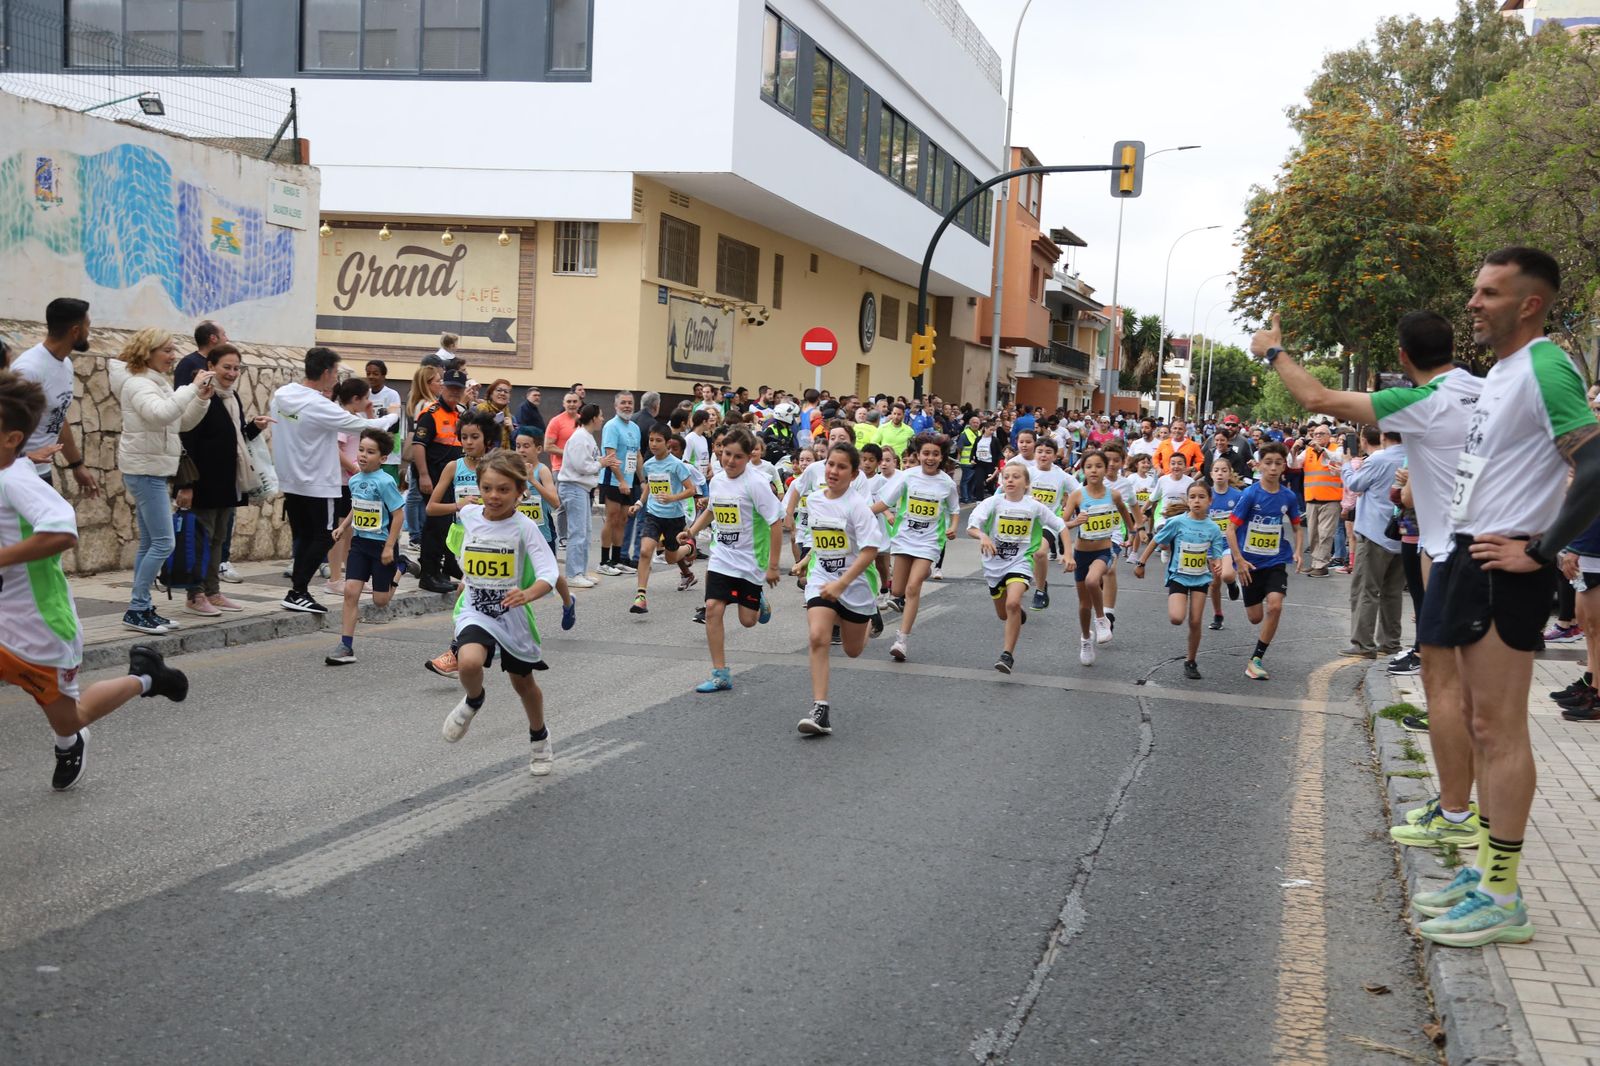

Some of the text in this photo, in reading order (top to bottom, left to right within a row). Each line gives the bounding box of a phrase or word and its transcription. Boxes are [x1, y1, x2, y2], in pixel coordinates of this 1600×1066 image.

[321, 240, 344, 257] LE
[333, 243, 468, 311] Grand
[456, 287, 501, 303] CAFÉ
[683, 315, 719, 360] Grand
[910, 503, 936, 517] 1033
[354, 514, 378, 528] 1022
[1085, 518, 1112, 532] 1016
[1000, 524, 1028, 535] 1039
[815, 534, 846, 550] 1049
[1249, 537, 1277, 550] 1034
[466, 558, 511, 578] 1051
